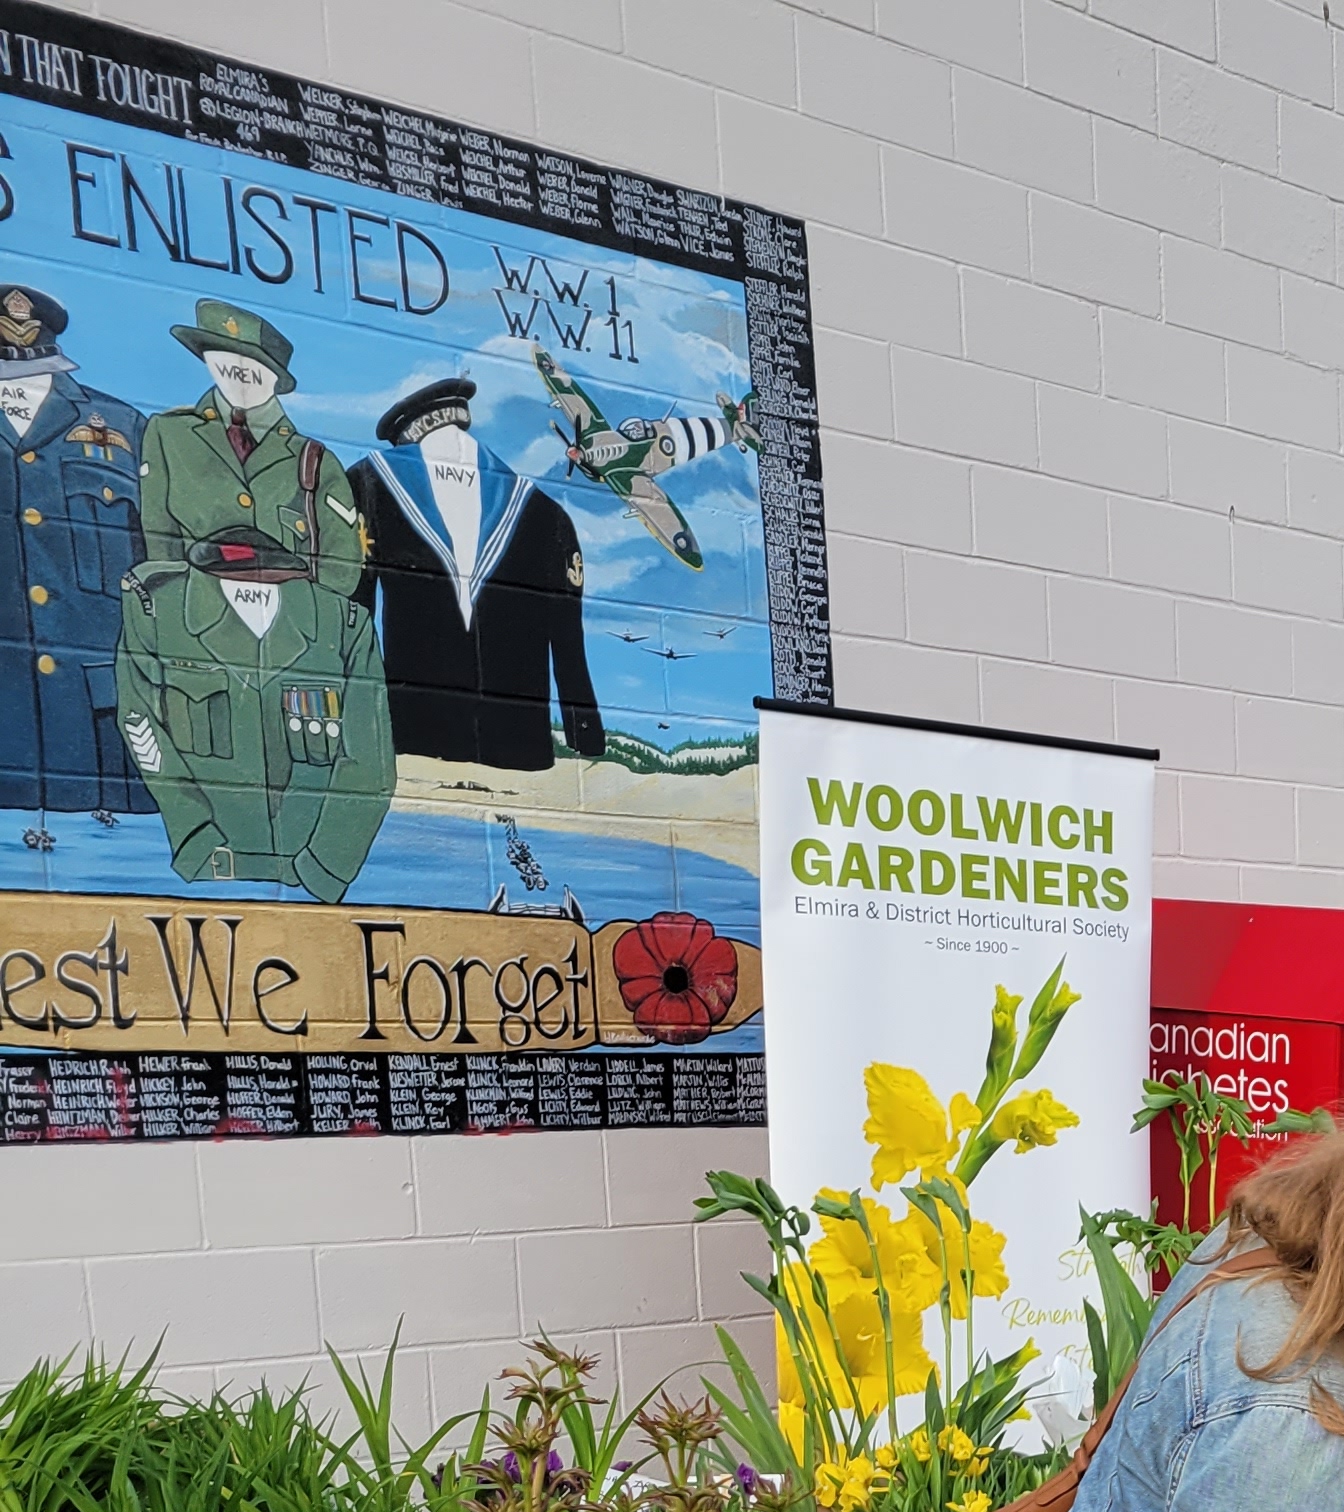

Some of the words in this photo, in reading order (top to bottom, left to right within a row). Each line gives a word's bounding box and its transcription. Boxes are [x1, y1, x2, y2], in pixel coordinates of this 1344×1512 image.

[15, 33, 83, 96] THAT
[89, 55, 193, 124] FOUGHT
[236, 123, 260, 142] 469
[62, 141, 450, 317] ENLISTED
[216, 362, 262, 386] WREN
[2, 387, 27, 400] AIR
[435, 465, 476, 487] NAVY
[234, 588, 271, 606] ARMY
[806, 776, 1113, 854] WOOLWICH
[790, 838, 1129, 912] GARDENERS
[794, 895, 860, 920] Elmira
[865, 901, 880, 921] &
[886, 901, 951, 926] District
[958, 908, 1068, 936] Horticultural
[1073, 917, 1129, 943] Society
[936, 936, 971, 954] Since
[975, 938, 1008, 954] 1900
[145, 913, 308, 1041] We
[351, 917, 590, 1048] Forget
[1150, 1022, 1290, 1064] anadian
[261, 1056, 292, 1070] Donald
[643, 1058, 664, 1072] James
[181, 1076, 206, 1090] John
[351, 1074, 380, 1089] Frank
[1152, 1059, 1289, 1113] iabetes
[183, 1092, 220, 1106] George
[355, 1091, 379, 1104] John
[422, 1089, 457, 1105] George
[570, 1088, 593, 1099] Eddie
[642, 1086, 662, 1098] John
[8, 1095, 46, 1109] Norman
[425, 1103, 444, 1115] Roy
[570, 1100, 600, 1112] Edward
[4, 1111, 40, 1125] Claire
[184, 1108, 220, 1120] Charles
[348, 1104, 377, 1118] James
[181, 1122, 216, 1134] William
[430, 1116, 450, 1129] Earl
